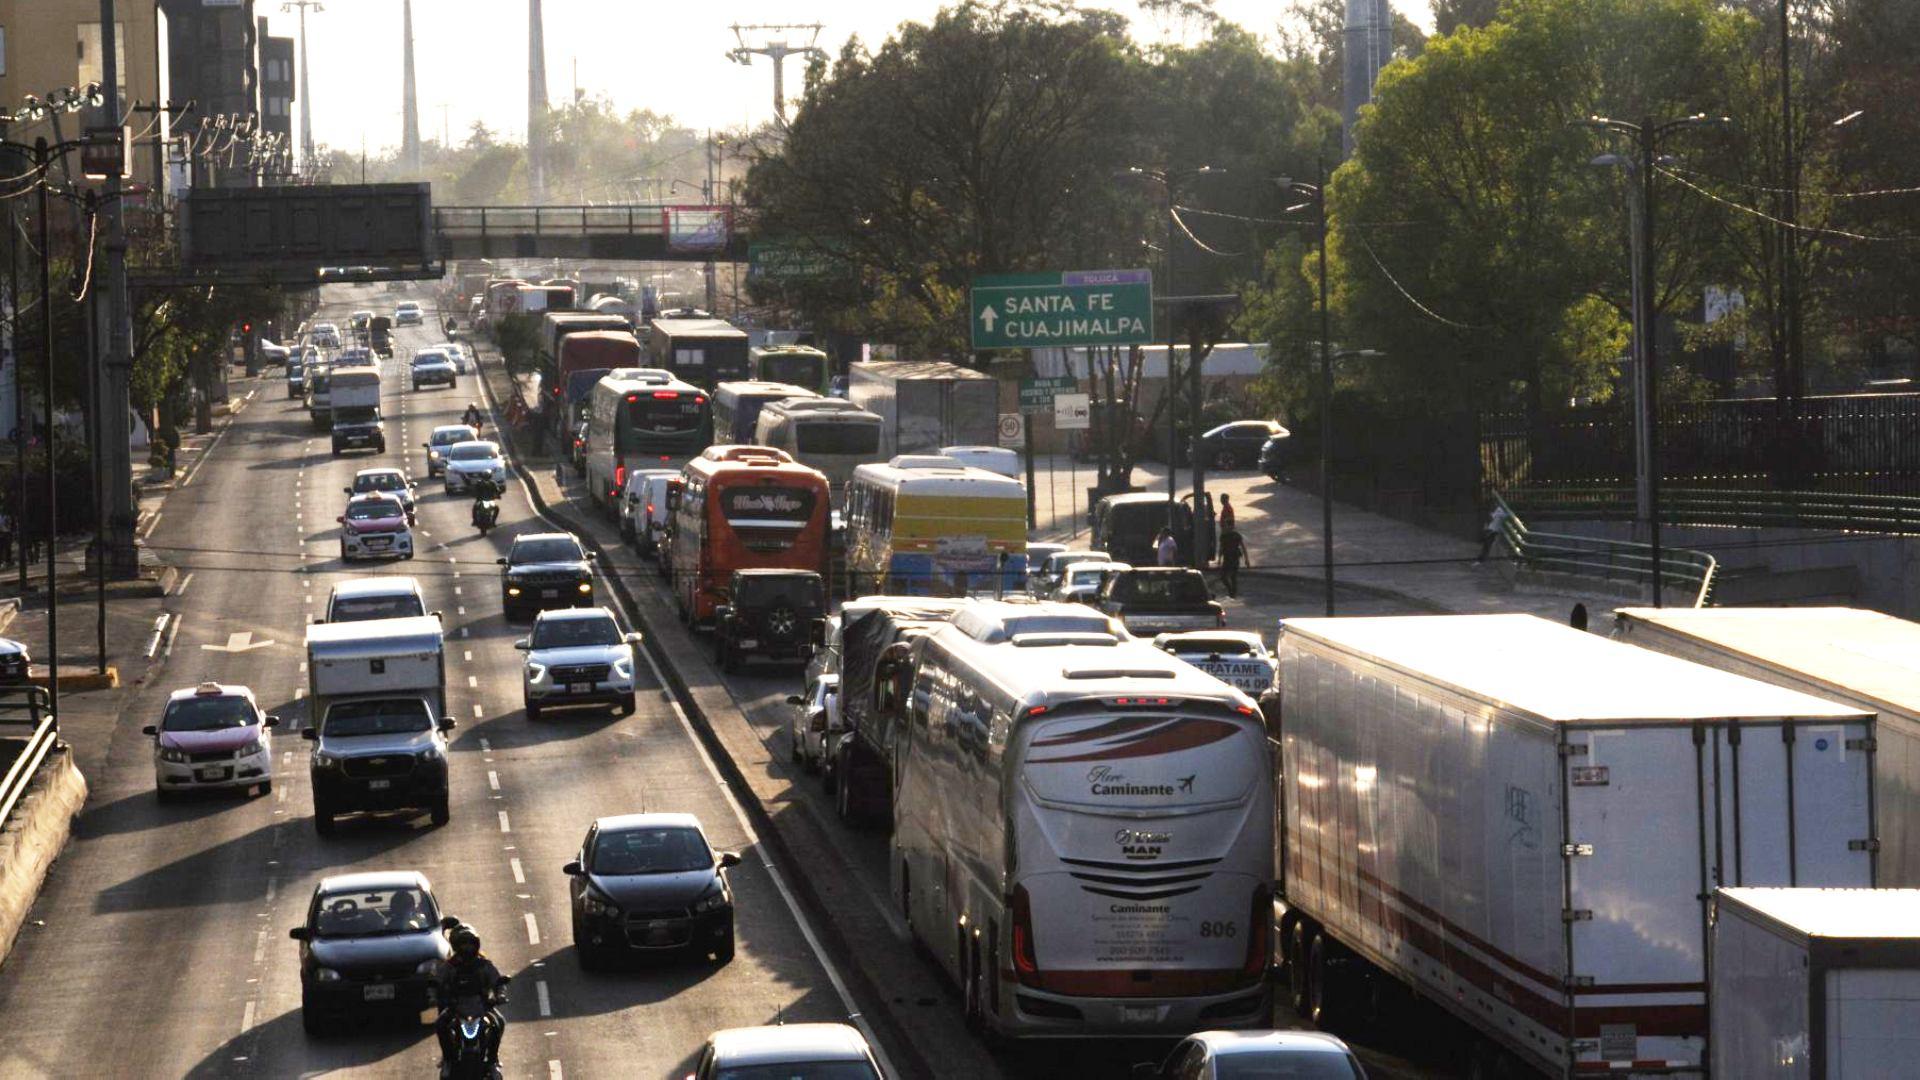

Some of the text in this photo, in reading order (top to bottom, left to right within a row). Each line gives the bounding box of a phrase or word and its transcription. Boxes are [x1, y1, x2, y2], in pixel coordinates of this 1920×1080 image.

[1083, 275, 1119, 283] TOLUCA
[1005, 293, 1114, 314] SANTA FE
[1005, 317, 1145, 338] CUAJIMALPA
[1091, 783, 1174, 796] Caminante
[1123, 846, 1161, 855] MAN
[1110, 903, 1170, 914] Caminante
[1200, 920, 1236, 938] 806
